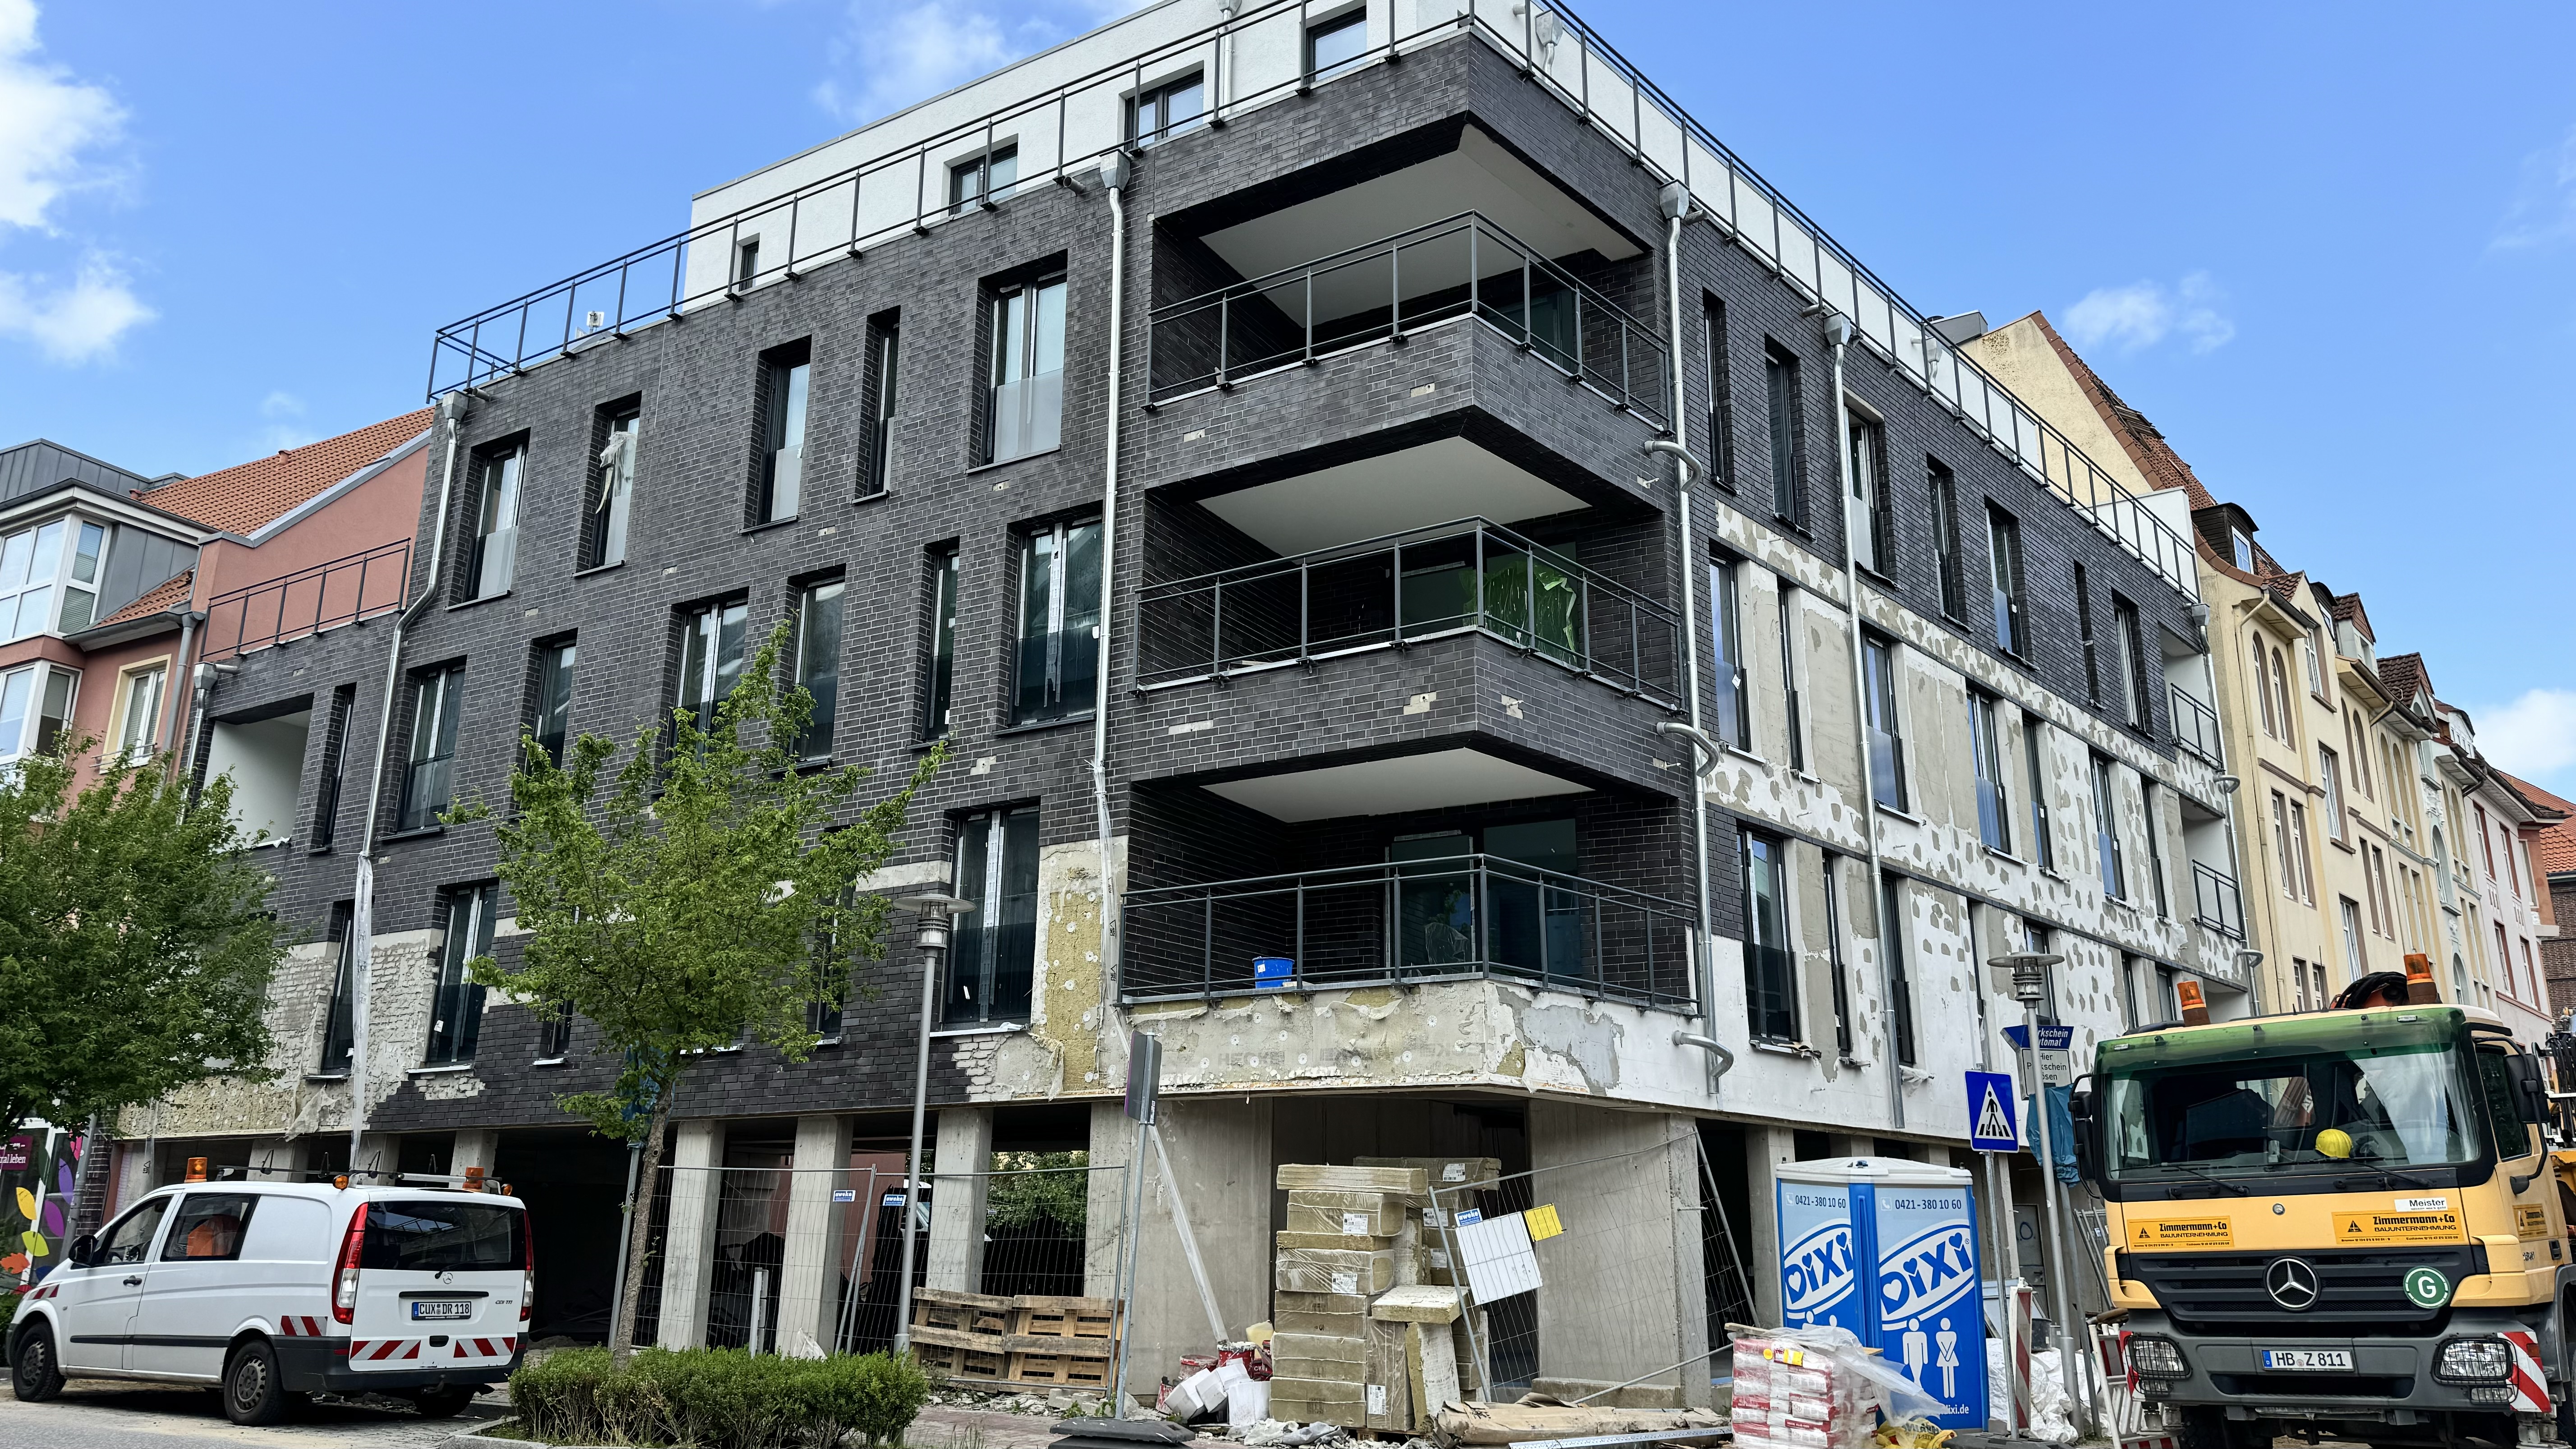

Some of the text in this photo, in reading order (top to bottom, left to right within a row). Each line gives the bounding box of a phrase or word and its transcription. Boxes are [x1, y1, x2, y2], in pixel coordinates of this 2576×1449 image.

[2038, 1028, 2068, 1037] rkschein
[1828, 1197, 1836, 1208] 10
[1838, 1198, 1846, 1208] 60
[1939, 1199, 1949, 1209] 10
[1951, 1199, 1962, 1210] 60
[2373, 1214, 2455, 1225] Zimmermann+Co
[2159, 1221, 2227, 1232] Zimmermann+Co
[2418, 1276, 2437, 1299] G
[419, 1303, 436, 1315] CUX
[442, 1303, 453, 1314] DR
[455, 1303, 469, 1314] 118
[2276, 1352, 2295, 1366] HB
[2304, 1352, 2315, 1366] Z
[2318, 1353, 2346, 1366] 811
